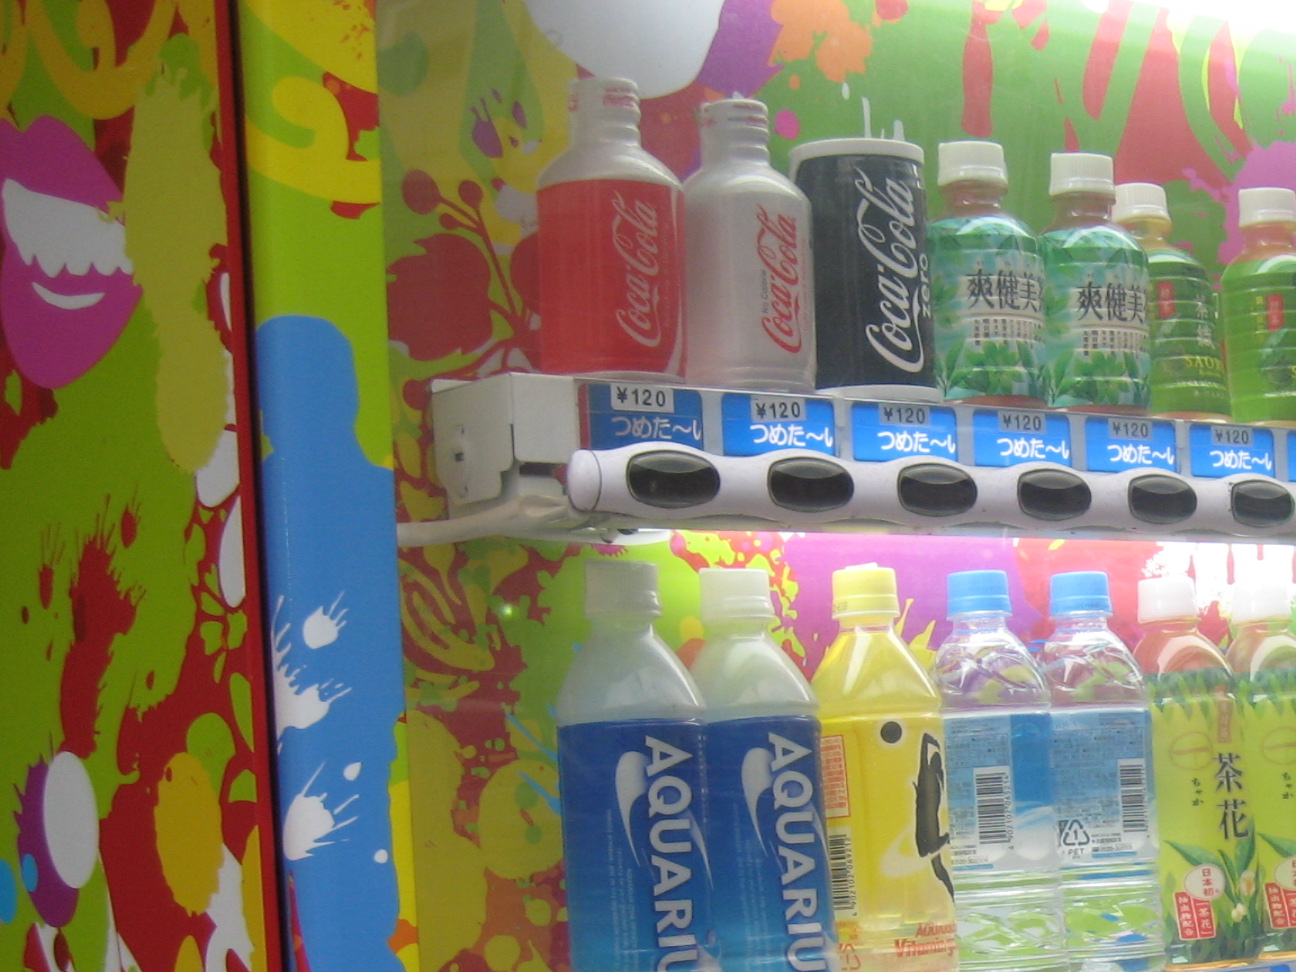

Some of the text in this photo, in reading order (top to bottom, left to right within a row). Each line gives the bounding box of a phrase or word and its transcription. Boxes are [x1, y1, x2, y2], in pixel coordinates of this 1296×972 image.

[613, 190, 662, 347] Coca-Cola
[756, 204, 802, 353] Coca-Cola
[854, 165, 924, 373] Coca-Cola
[966, 268, 1044, 312] 爽健美
[1077, 281, 1148, 323] 爽健美
[616, 387, 666, 407] ¥120
[756, 401, 801, 420] ¥120
[883, 407, 926, 423] ¥120
[1002, 415, 1042, 431] ¥120
[1112, 420, 1149, 438] ¥120
[1215, 427, 1249, 444] ¥120
[1212, 752, 1250, 840] 茶花
